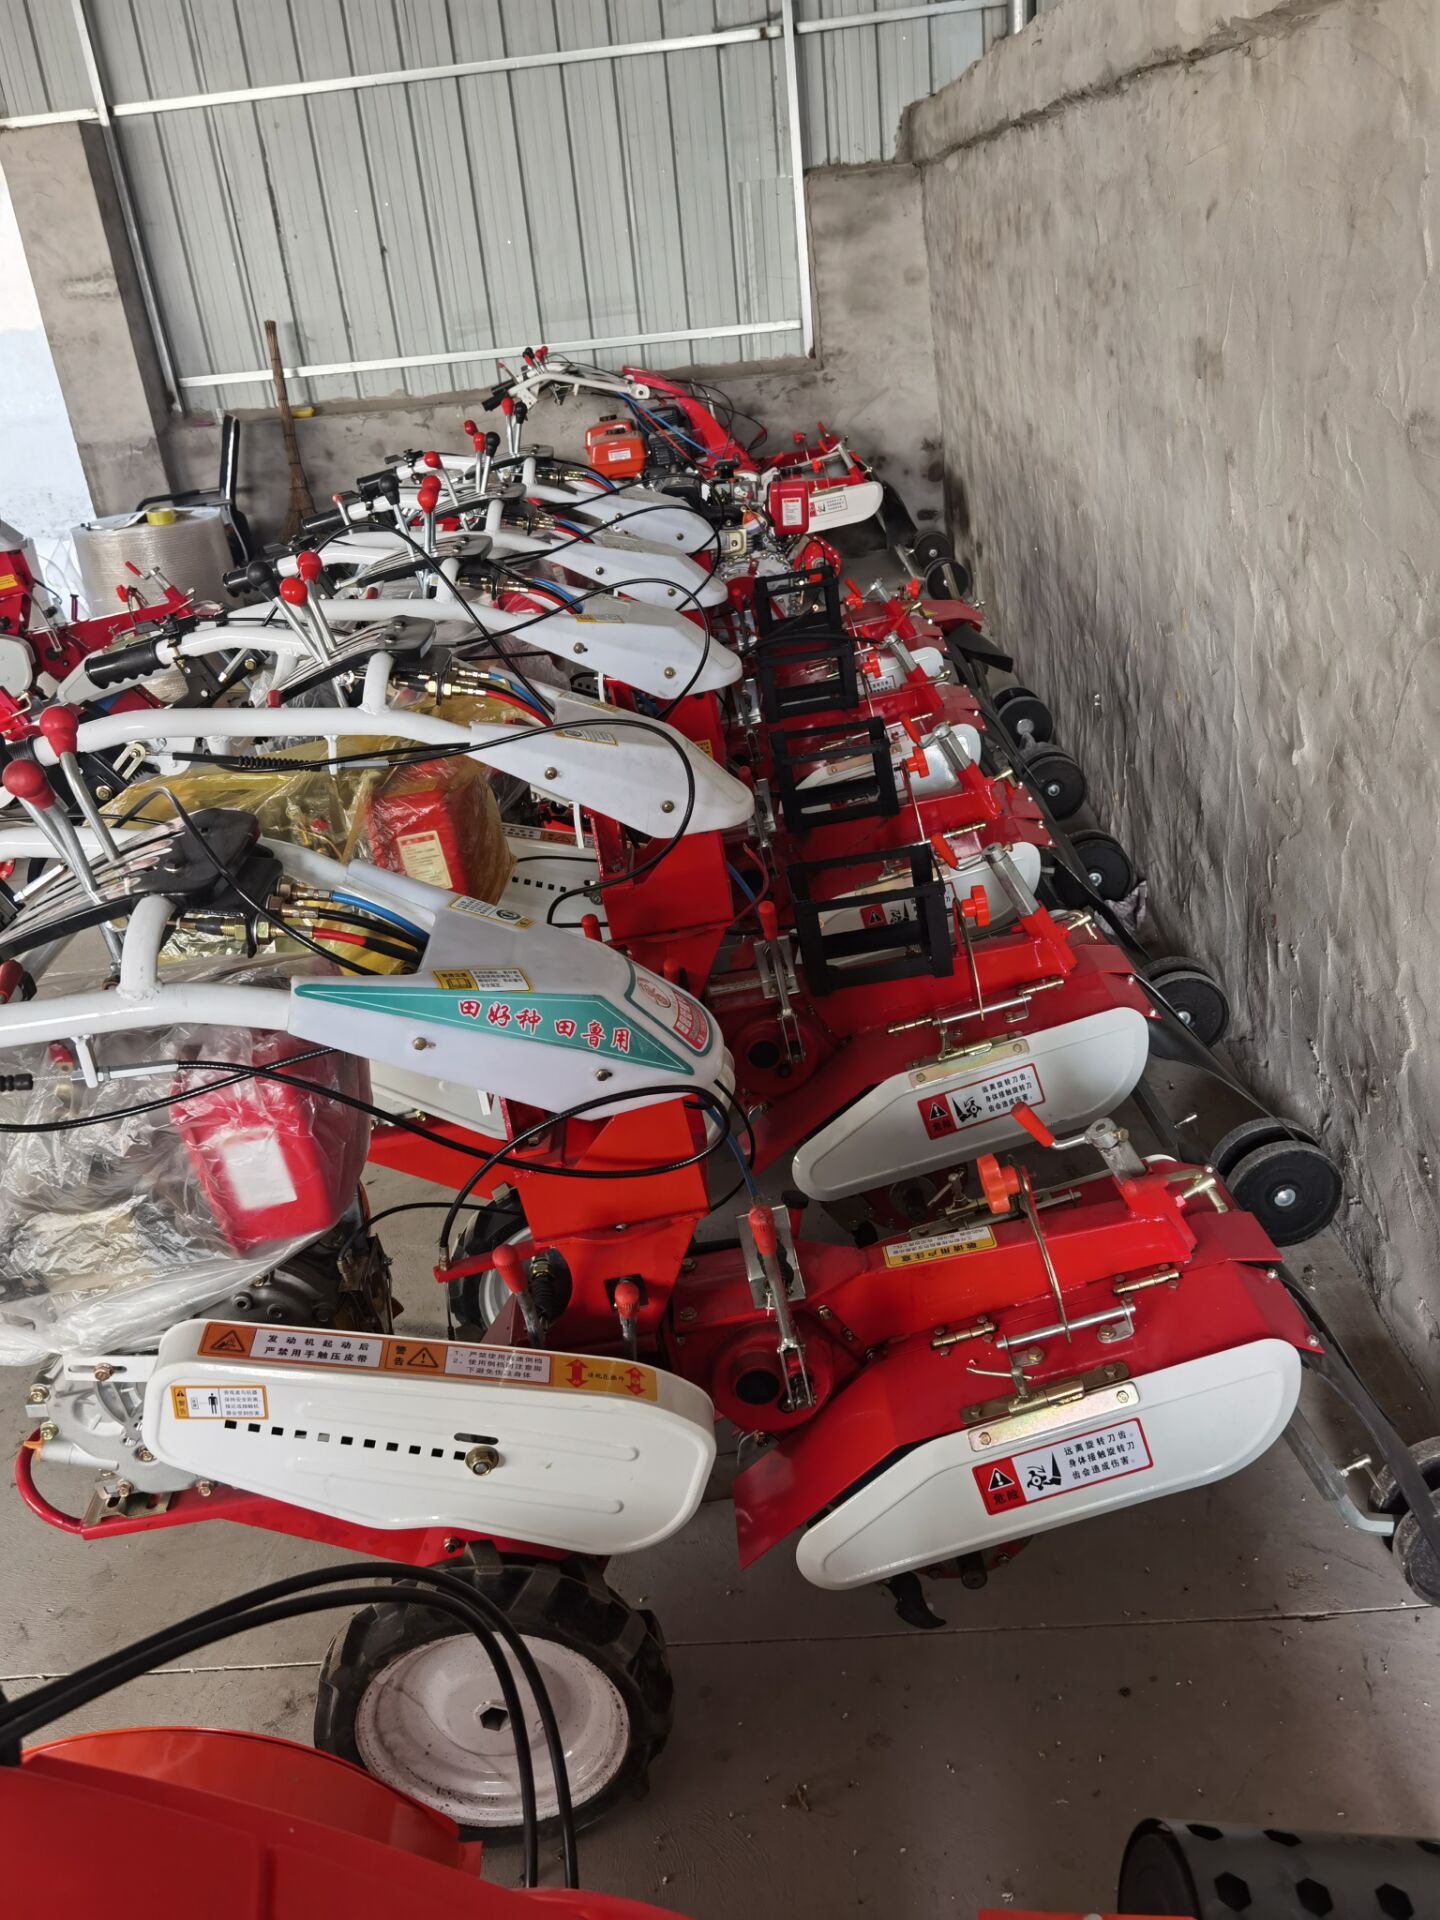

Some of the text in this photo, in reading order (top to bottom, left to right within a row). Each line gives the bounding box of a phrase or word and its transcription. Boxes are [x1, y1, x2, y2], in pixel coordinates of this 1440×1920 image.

[267, 1334, 369, 1351] 发动机起动后
[264, 1346, 368, 1363] 严禁用手触压皮带
[1068, 1441, 1136, 1468] 身体接触旋转刀
[993, 1488, 1019, 1505] 危险
